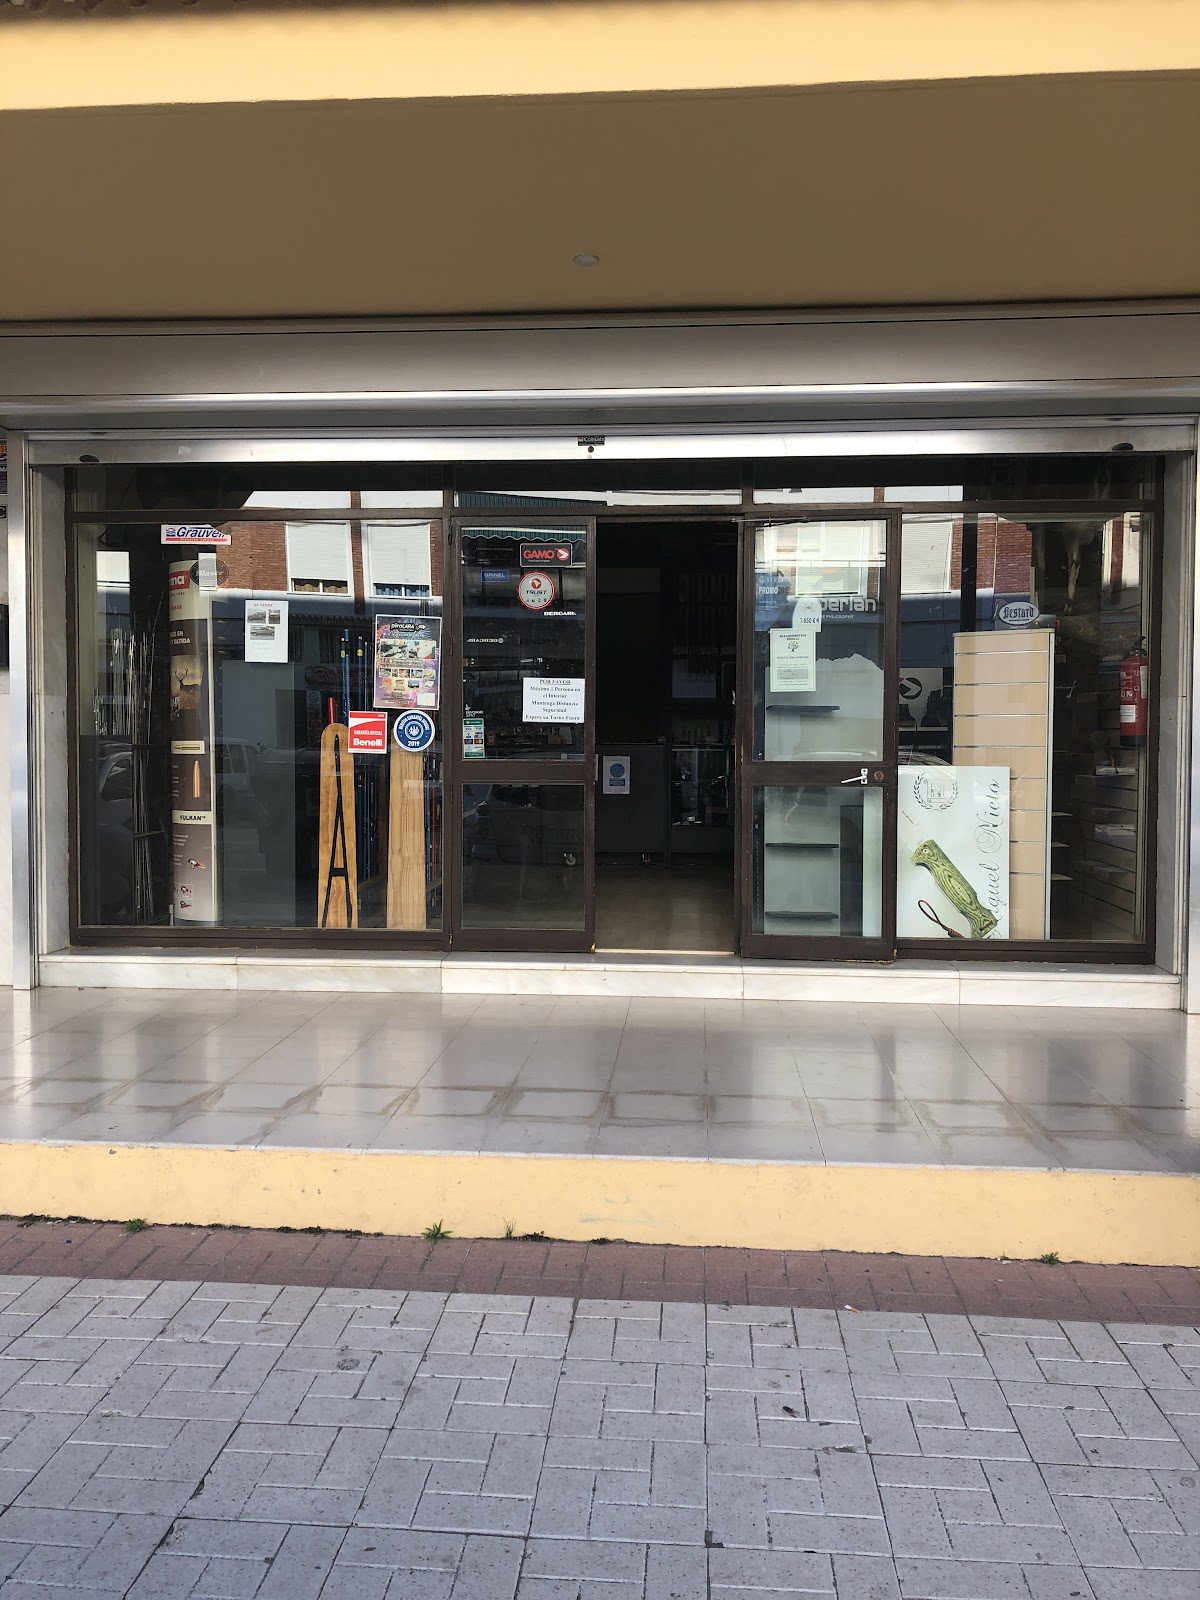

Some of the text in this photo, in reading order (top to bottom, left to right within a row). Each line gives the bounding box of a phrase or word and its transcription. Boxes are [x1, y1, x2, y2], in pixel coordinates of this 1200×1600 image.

[523, 549, 554, 559] GAMO
[353, 738, 382, 747] Benelli
[979, 862, 1008, 936] iguel
